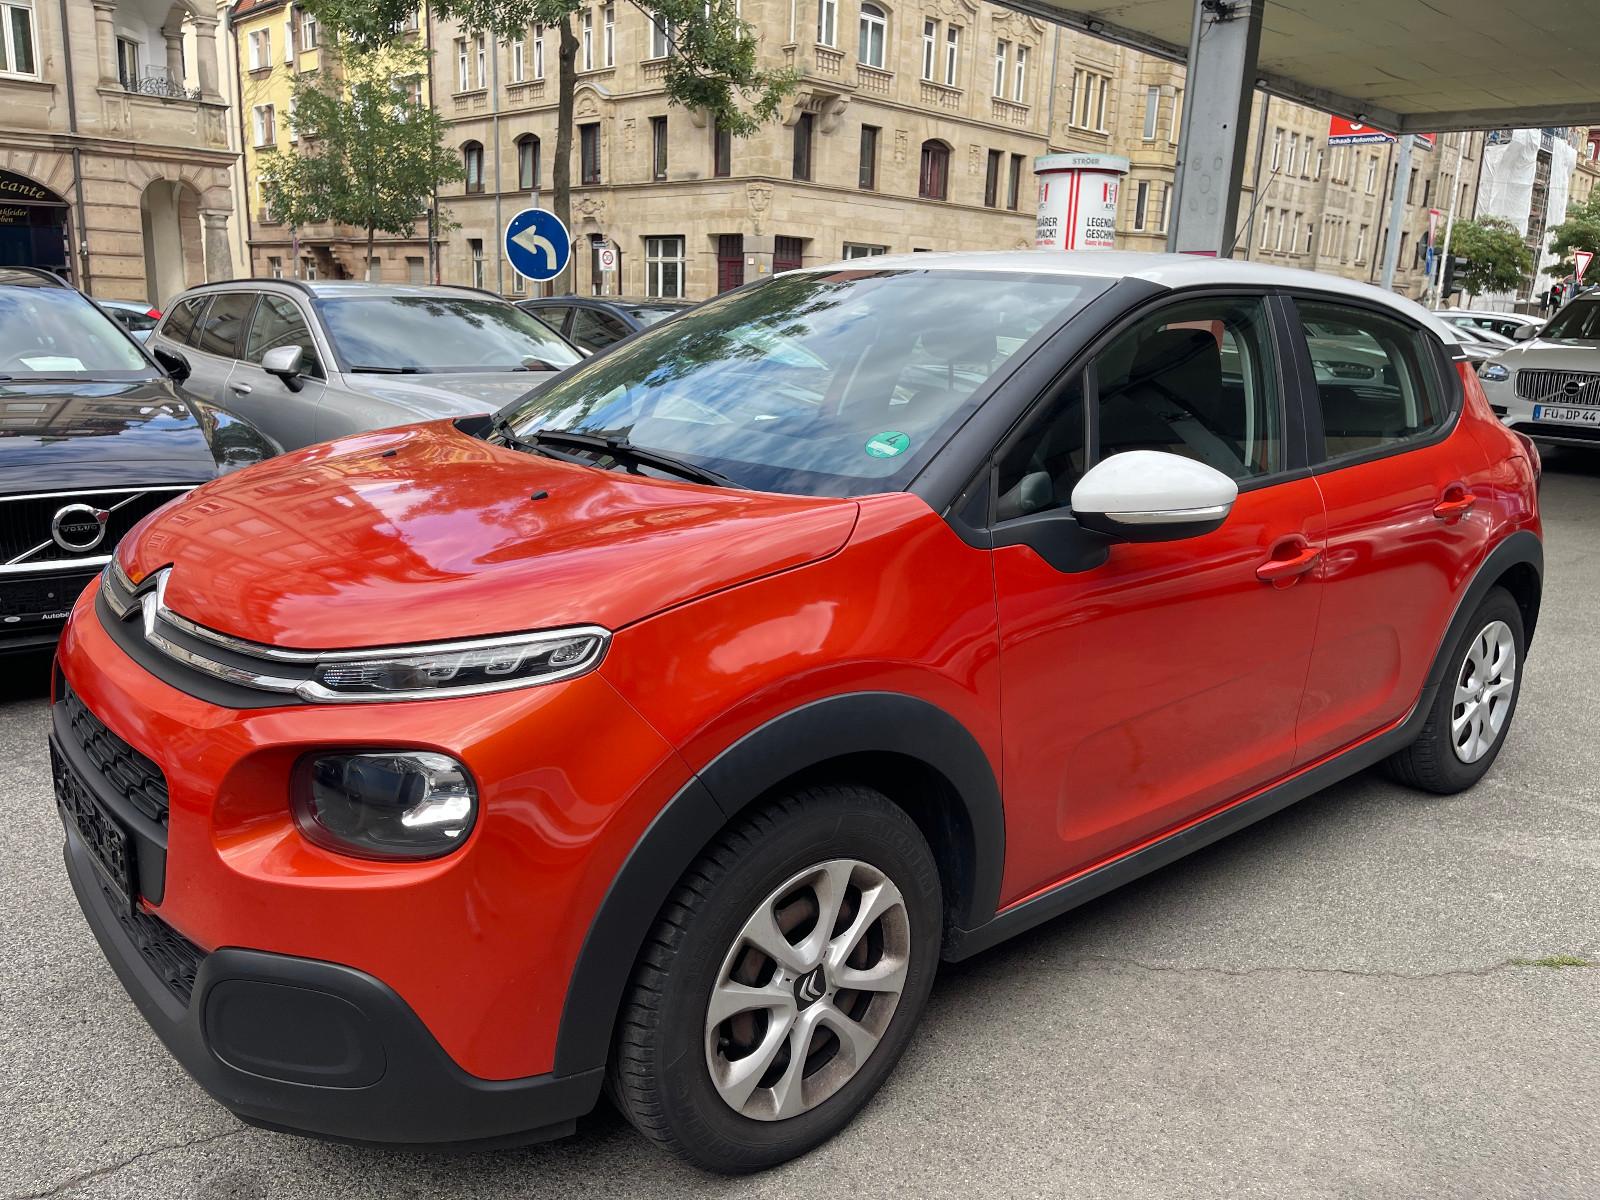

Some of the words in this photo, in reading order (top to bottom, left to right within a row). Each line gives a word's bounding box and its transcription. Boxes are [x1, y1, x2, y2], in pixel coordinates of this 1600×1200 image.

[0, 181, 45, 198] cante
[1037, 216, 1058, 227] DÄRER
[1036, 228, 1057, 239] MACK!
[1566, 410, 1580, 420] DP
[1582, 411, 1596, 421] 44
